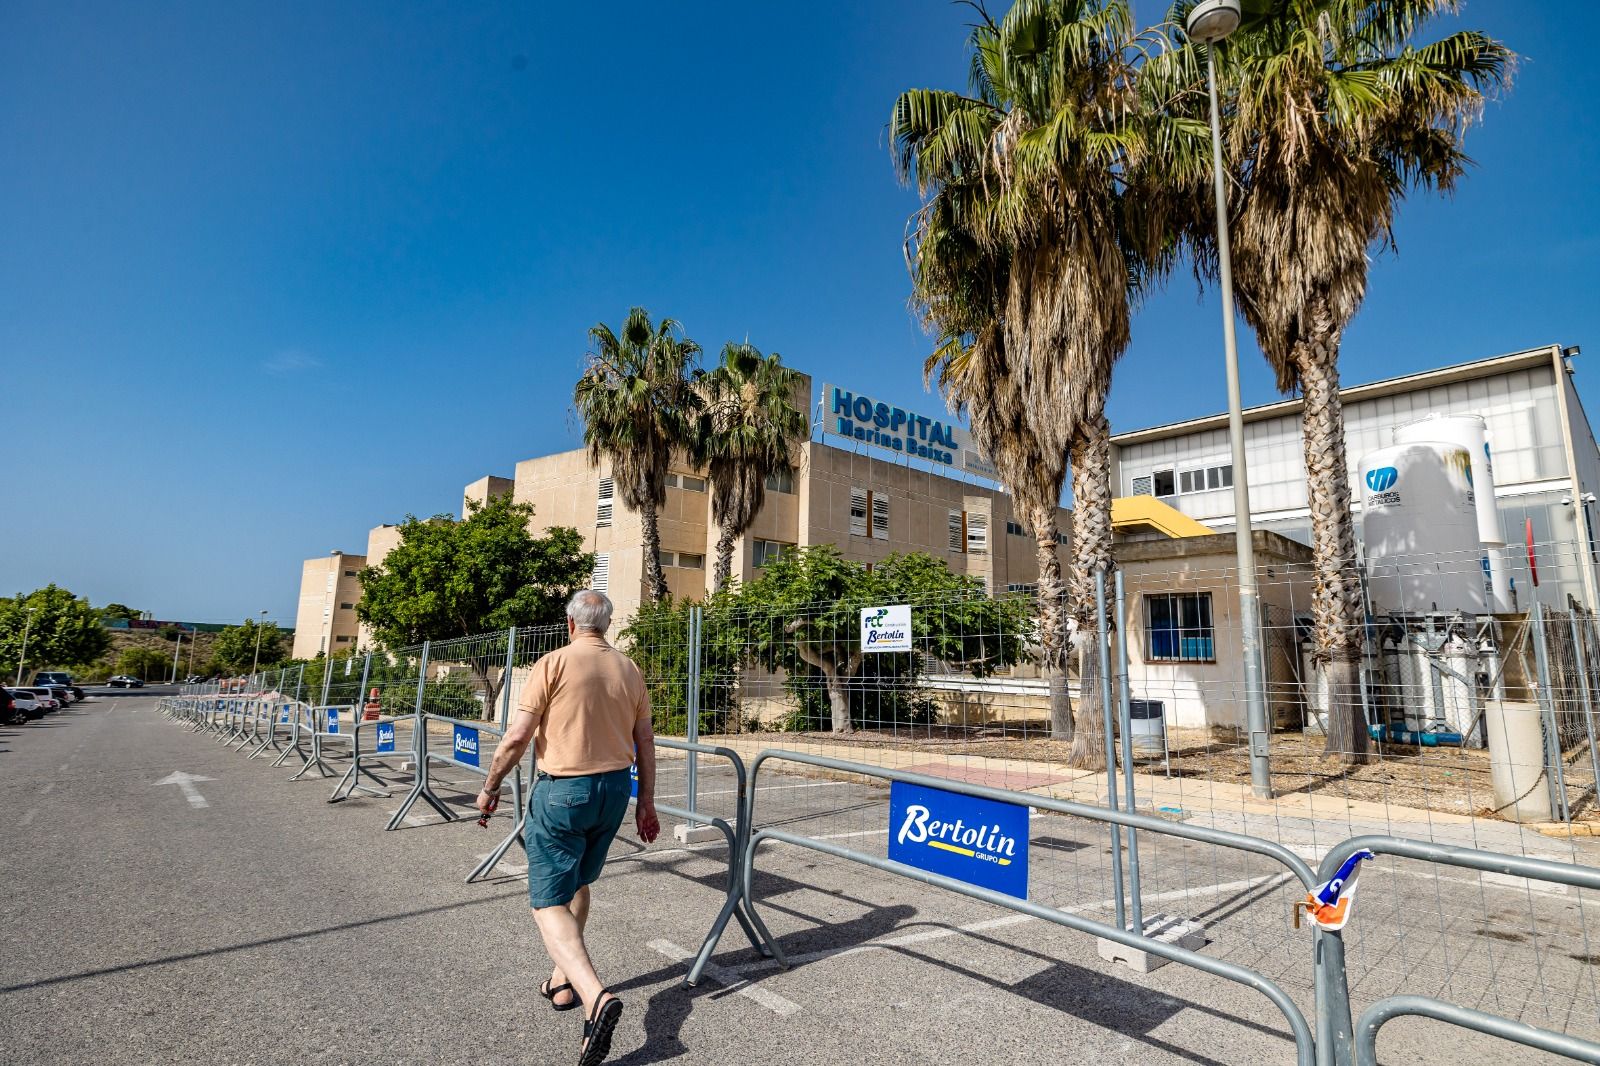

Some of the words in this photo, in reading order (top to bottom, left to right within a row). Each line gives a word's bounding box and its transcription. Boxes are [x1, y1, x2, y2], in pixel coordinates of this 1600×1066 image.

[832, 387, 958, 449] HOSPITAL
[838, 417, 902, 450] Marina
[907, 438, 953, 464] Baixa
[865, 616, 883, 628] FCC
[975, 852, 998, 864] GRUPO
